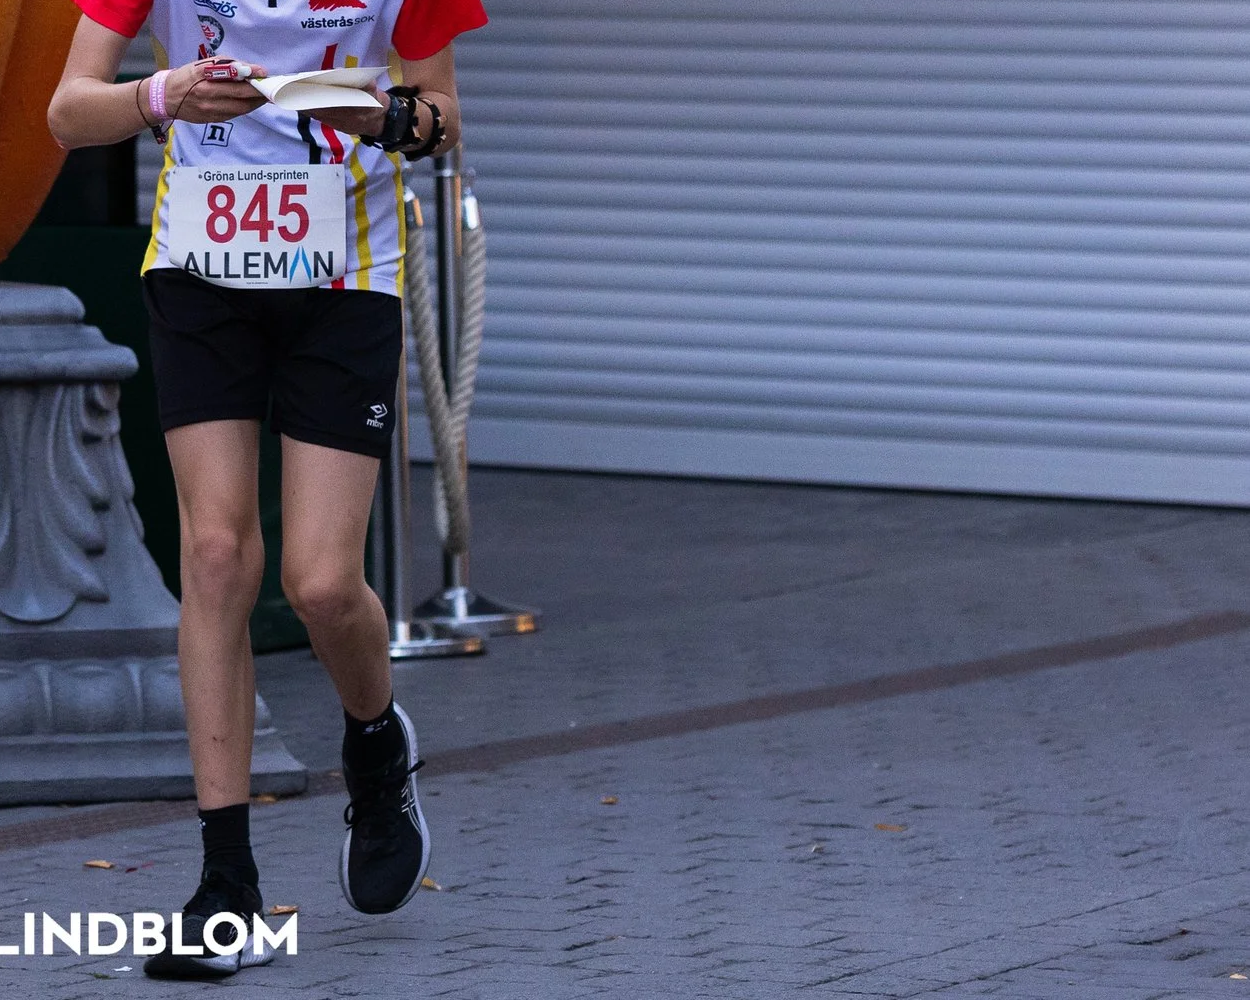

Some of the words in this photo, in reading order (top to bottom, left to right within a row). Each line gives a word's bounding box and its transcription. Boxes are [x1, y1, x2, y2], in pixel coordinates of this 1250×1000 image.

[301, 16, 353, 29] västerås
[204, 169, 235, 182] Gröna
[237, 169, 310, 183] Lund-sprinten
[205, 183, 310, 244] 845
